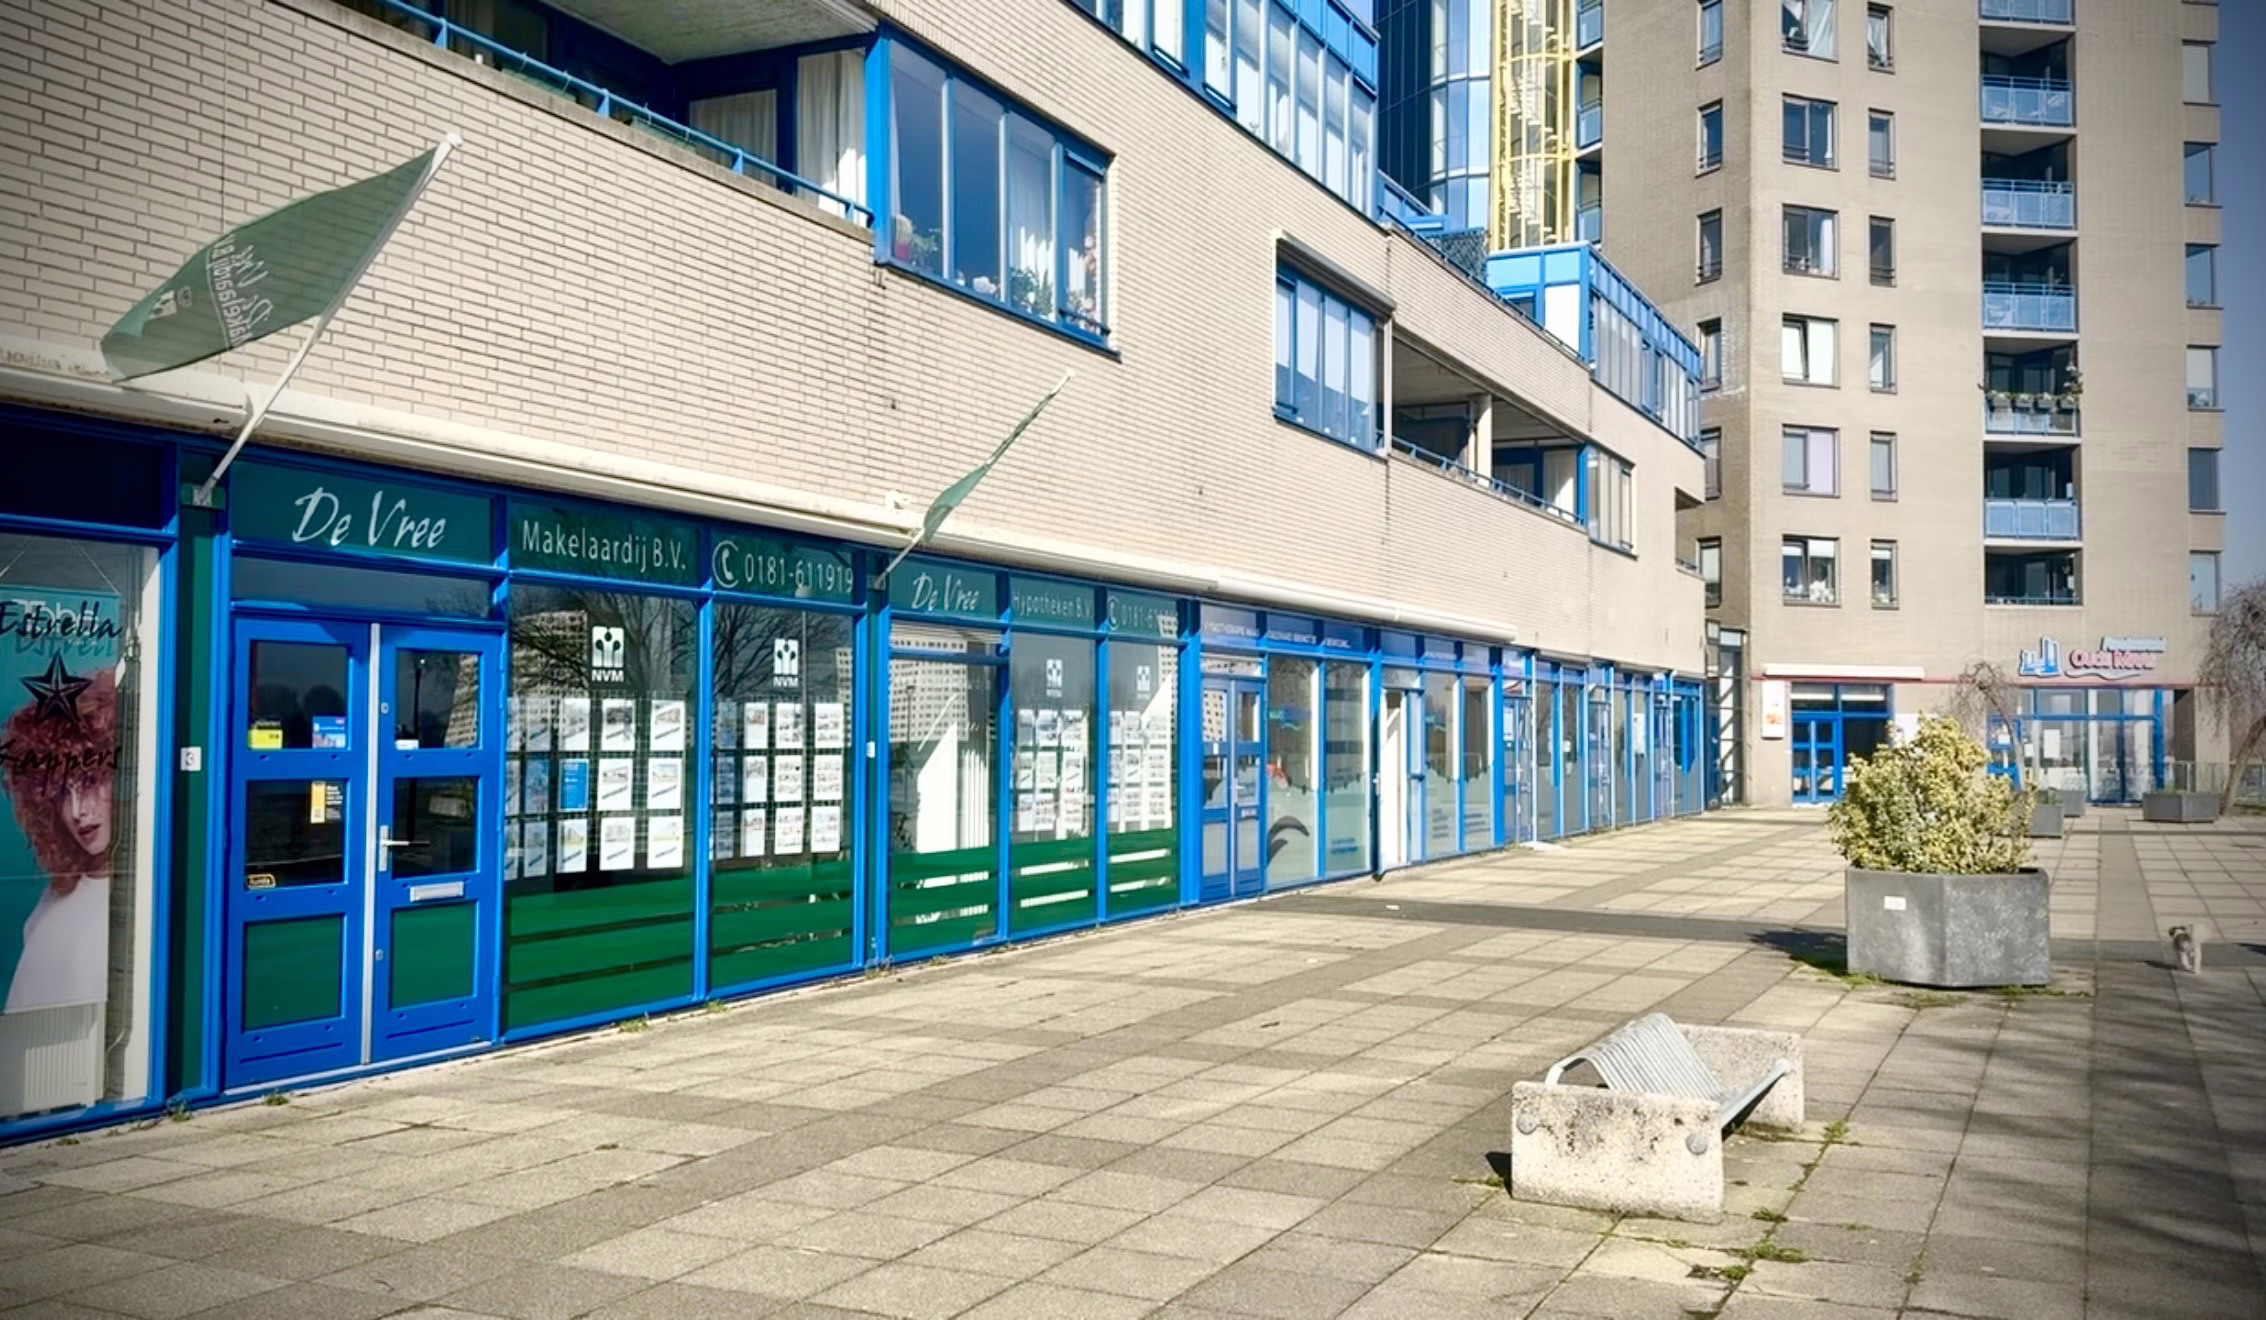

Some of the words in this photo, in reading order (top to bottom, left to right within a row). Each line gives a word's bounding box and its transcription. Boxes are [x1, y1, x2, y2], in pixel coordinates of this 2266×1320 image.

[292, 487, 352, 546] De
[368, 491, 447, 548] Vree
[522, 519, 646, 574] Makelaardij
[653, 537, 687, 570] B.V.
[745, 553, 853, 593] 0181-611919
[912, 572, 938, 611] De
[944, 574, 980, 611] Vree
[0, 601, 123, 639] Estrella
[591, 669, 625, 682] NVM
[773, 675, 799, 687] NVM
[185, 751, 194, 766] 3
